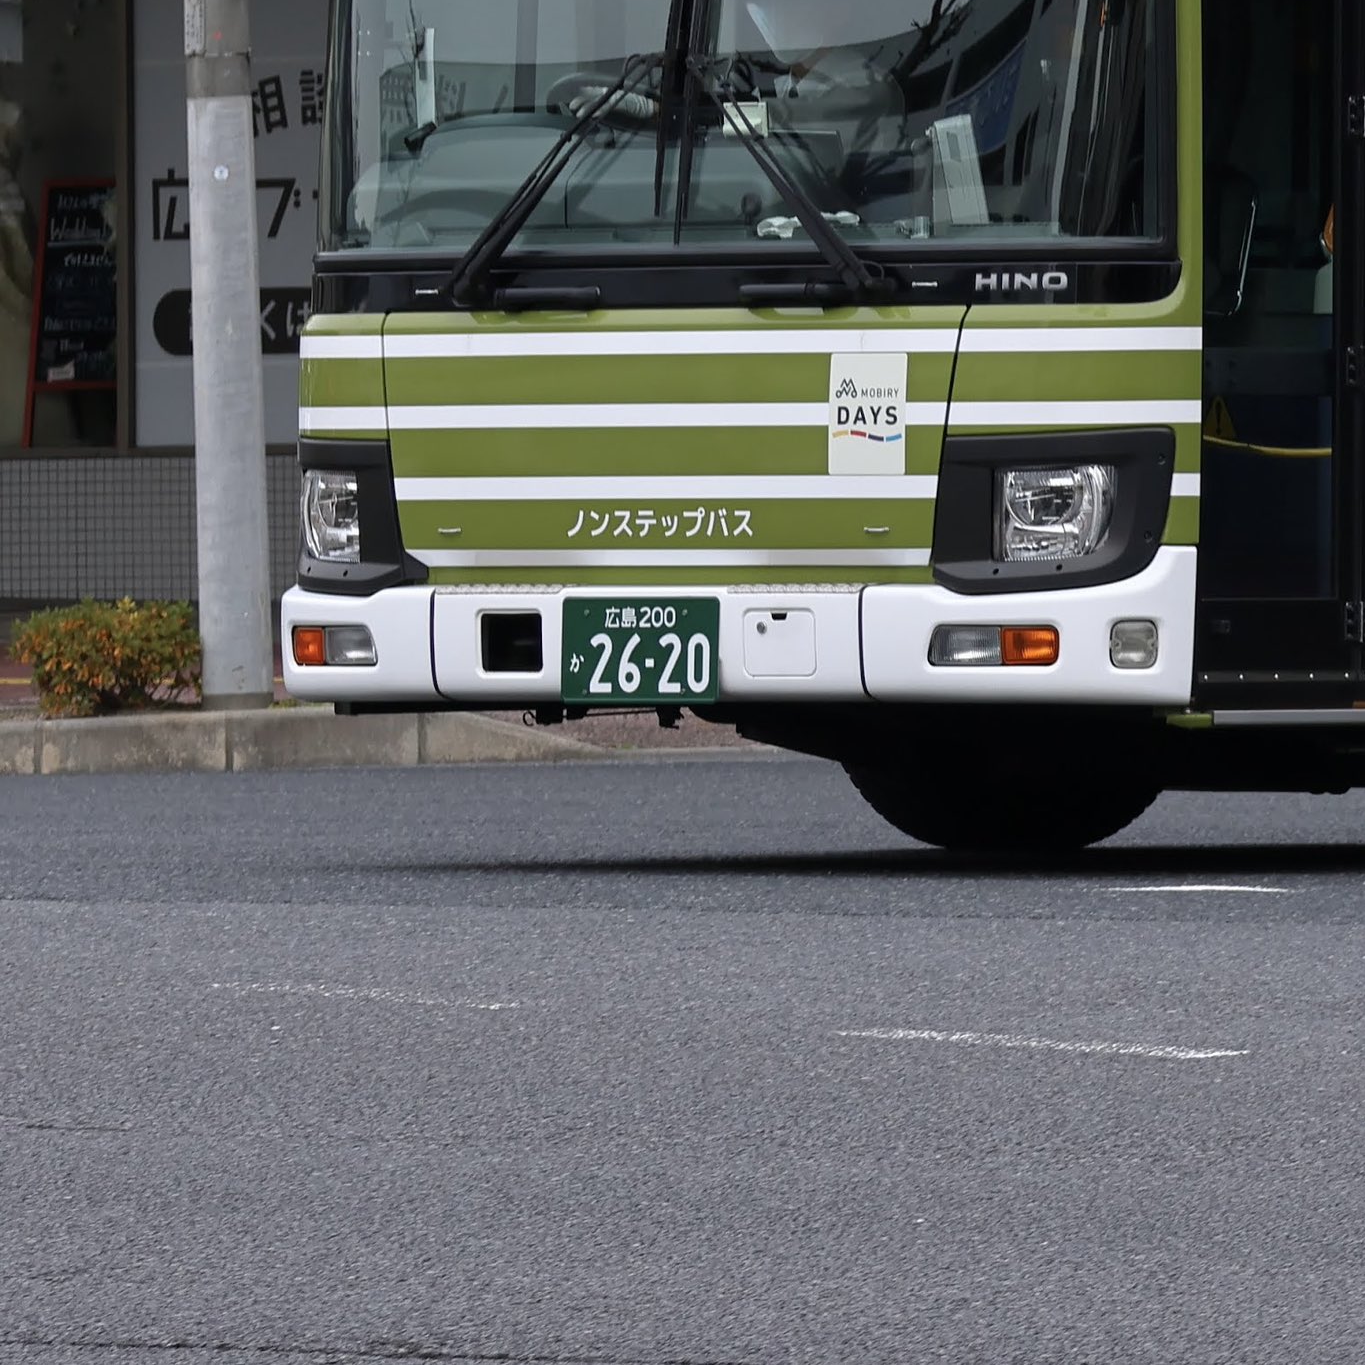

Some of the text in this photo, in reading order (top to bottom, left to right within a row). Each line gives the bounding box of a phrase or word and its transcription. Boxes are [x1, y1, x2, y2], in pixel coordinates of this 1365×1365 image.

[975, 272, 1068, 291] HINO
[861, 388, 899, 398] MOBIRY
[837, 406, 898, 425] DAYS
[567, 506, 753, 537] ノンステップバス
[569, 633, 710, 693] か 26-20
